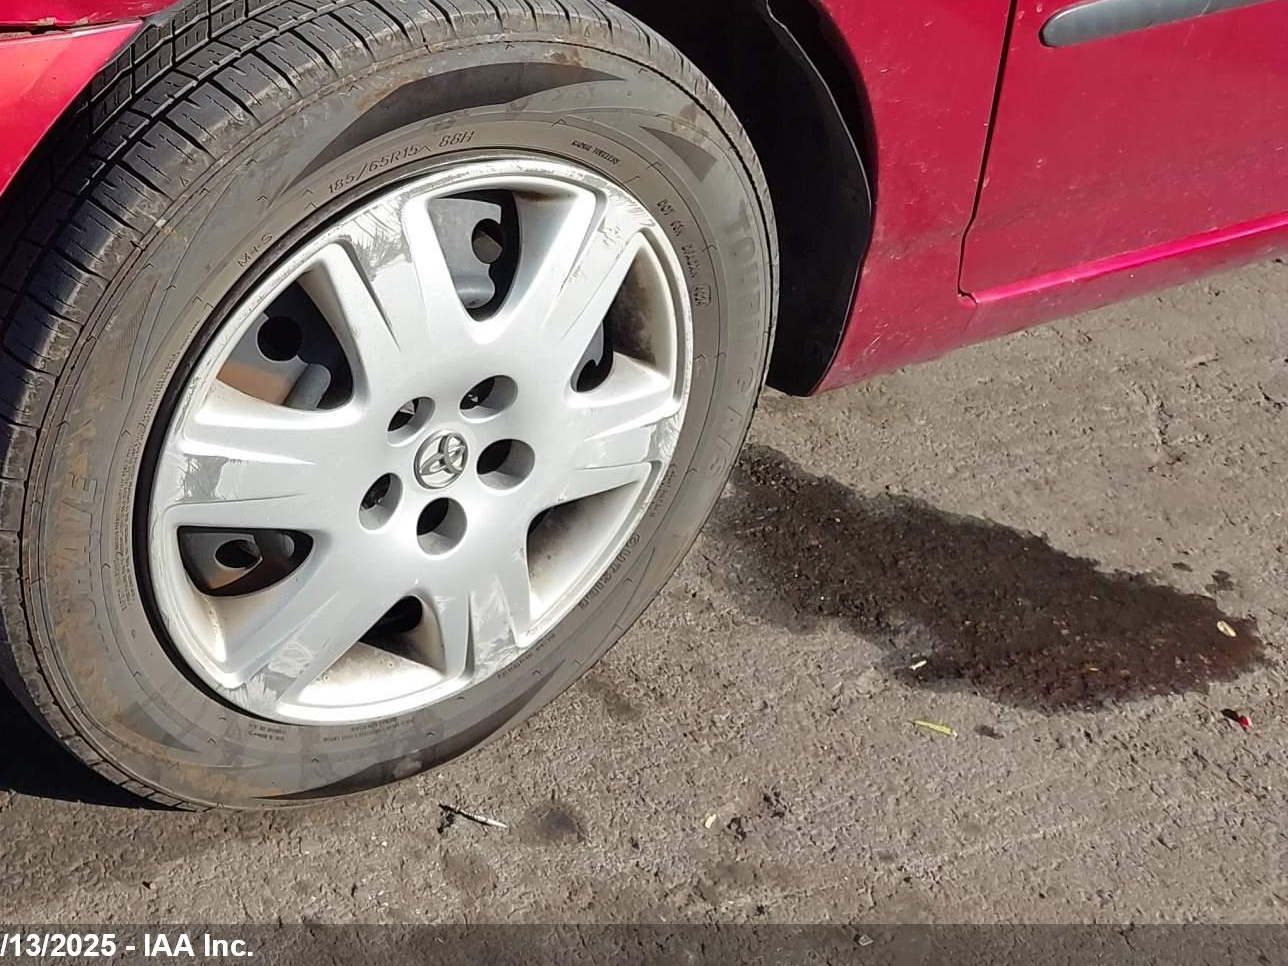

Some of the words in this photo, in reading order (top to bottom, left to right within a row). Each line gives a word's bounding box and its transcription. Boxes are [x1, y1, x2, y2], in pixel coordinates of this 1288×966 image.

[328, 144, 419, 194] 185/65R15
[438, 130, 475, 148] 88H
[237, 233, 273, 267] M+S
